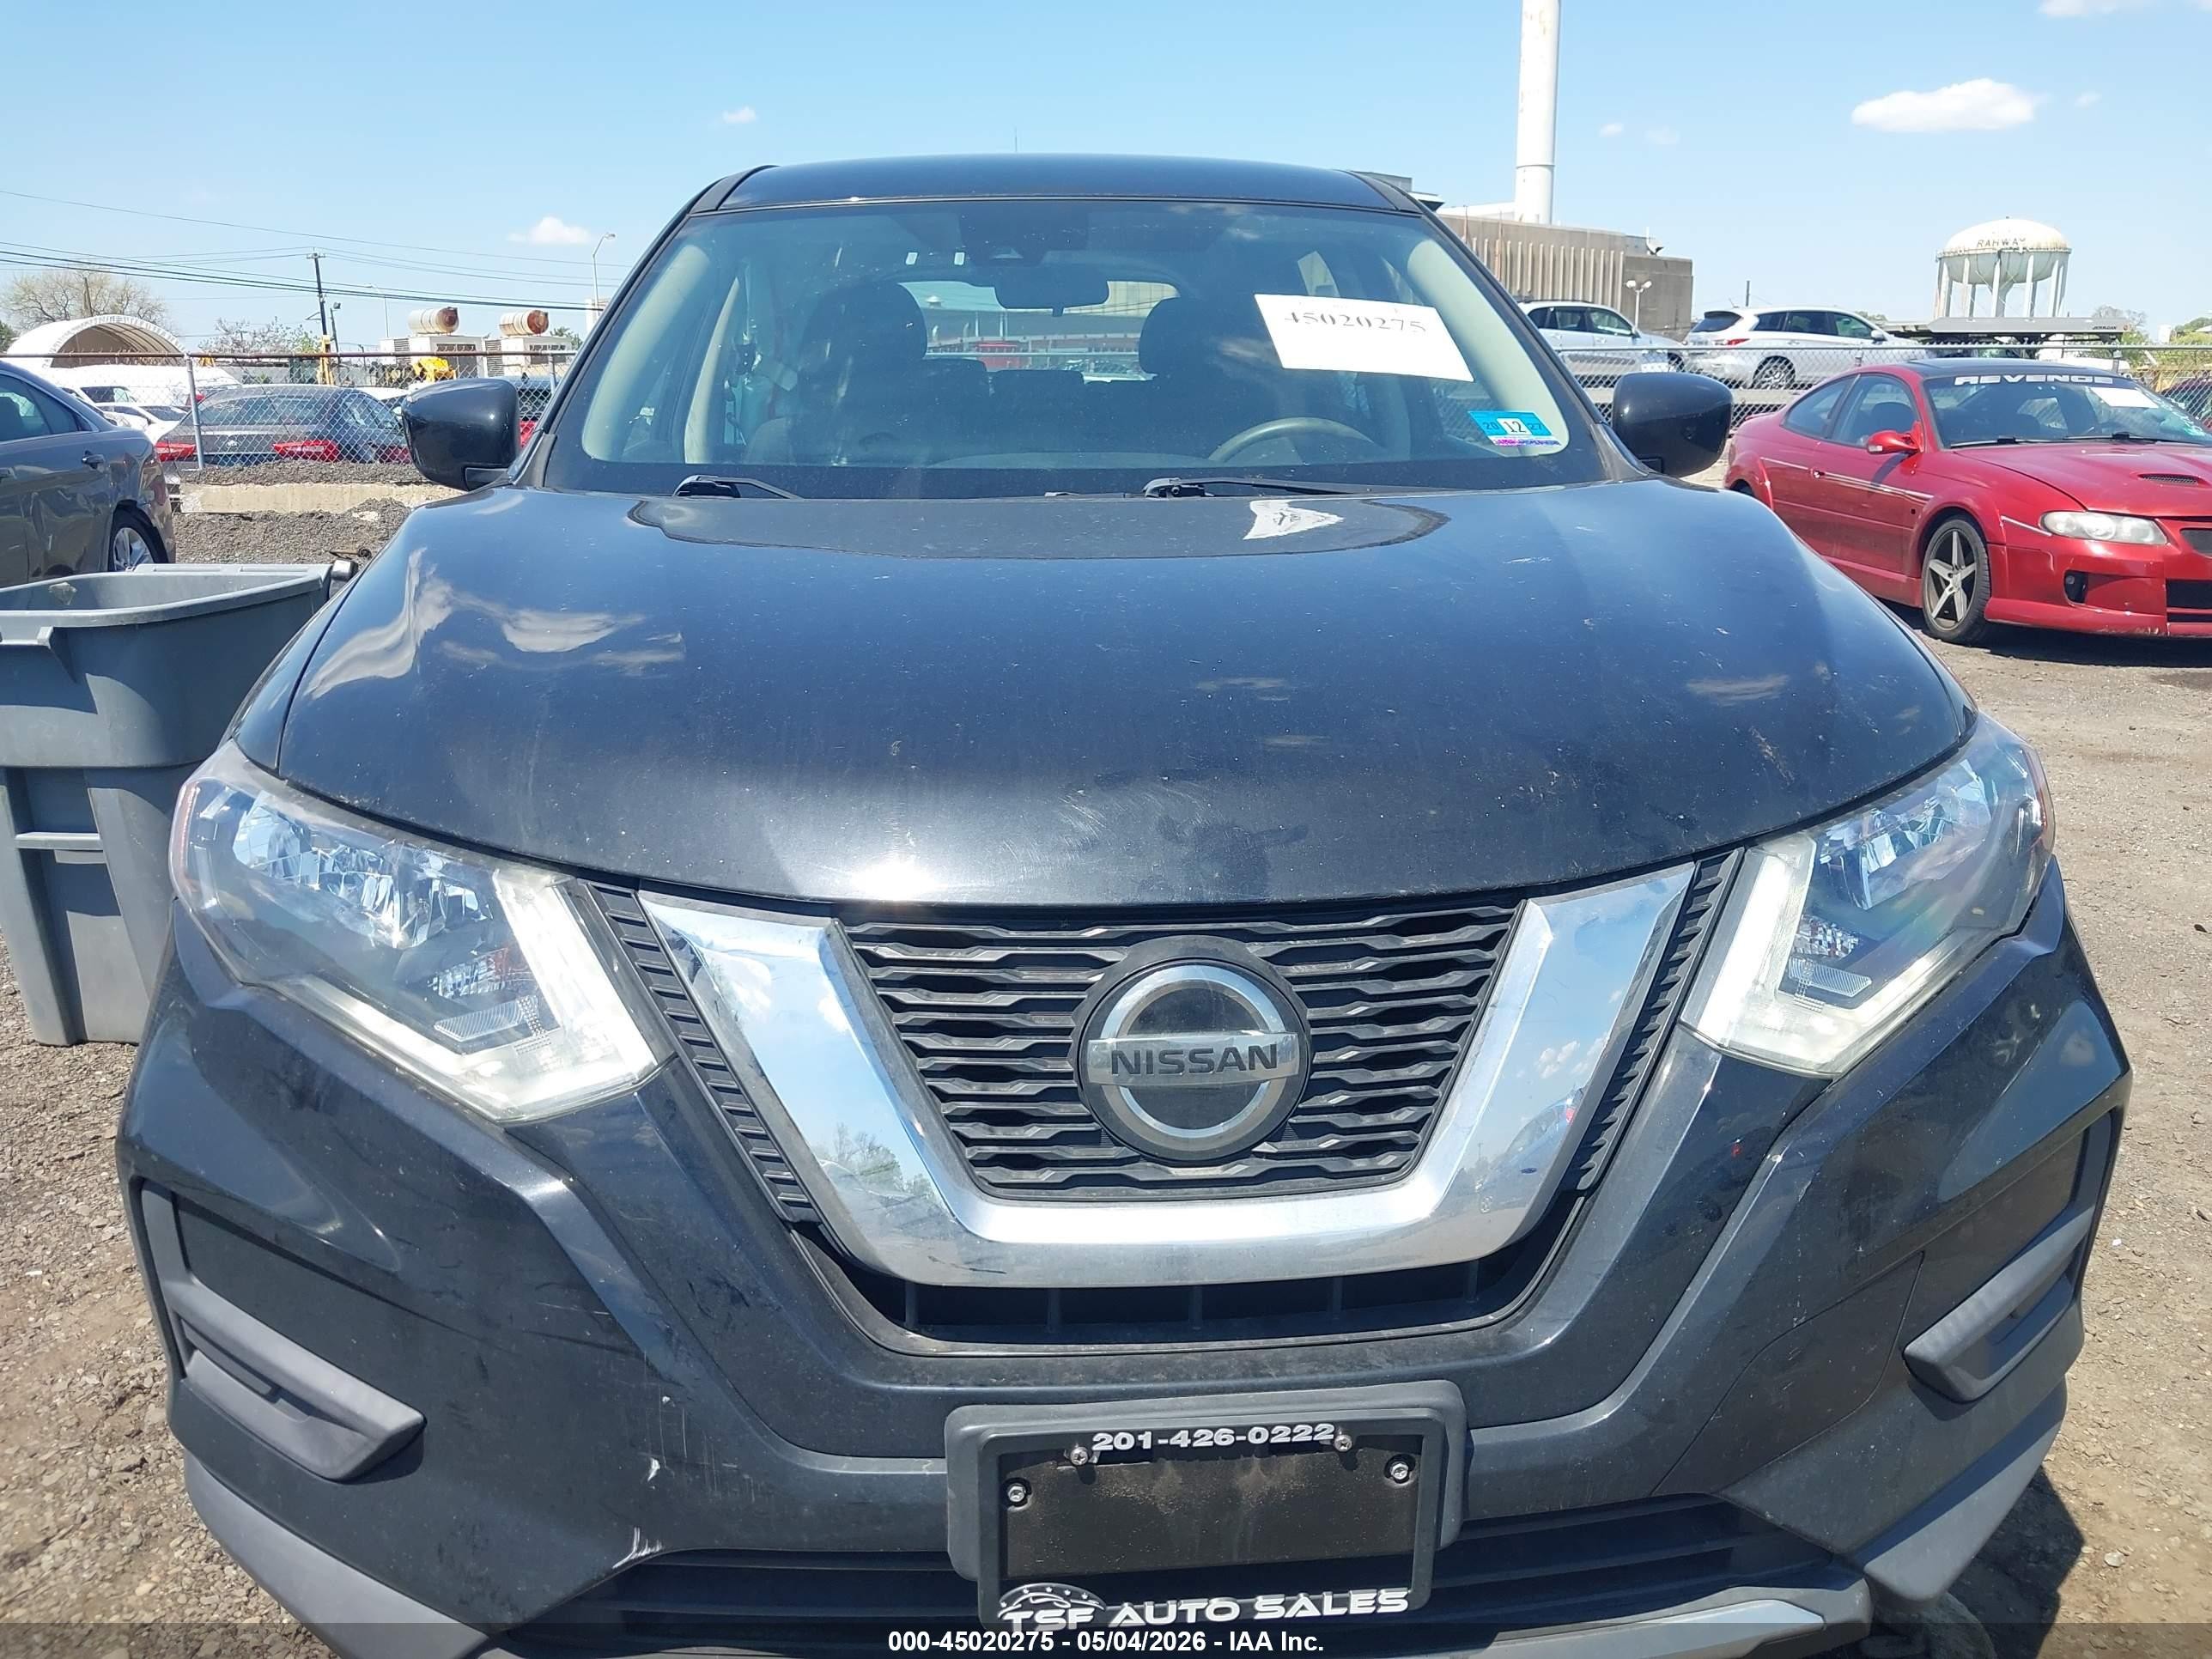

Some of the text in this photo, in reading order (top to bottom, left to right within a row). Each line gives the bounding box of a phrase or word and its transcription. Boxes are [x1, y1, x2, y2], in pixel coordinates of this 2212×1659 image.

[1977, 238, 2026, 248] RAHWAY
[1284, 311, 1426, 332] 45020275
[1503, 421, 1528, 433] 12
[1111, 1043, 1278, 1075] NISSAN
[1091, 1423, 1334, 1451] 201-426-0222
[1002, 1587, 1409, 1632] TSF AUTO SALES
